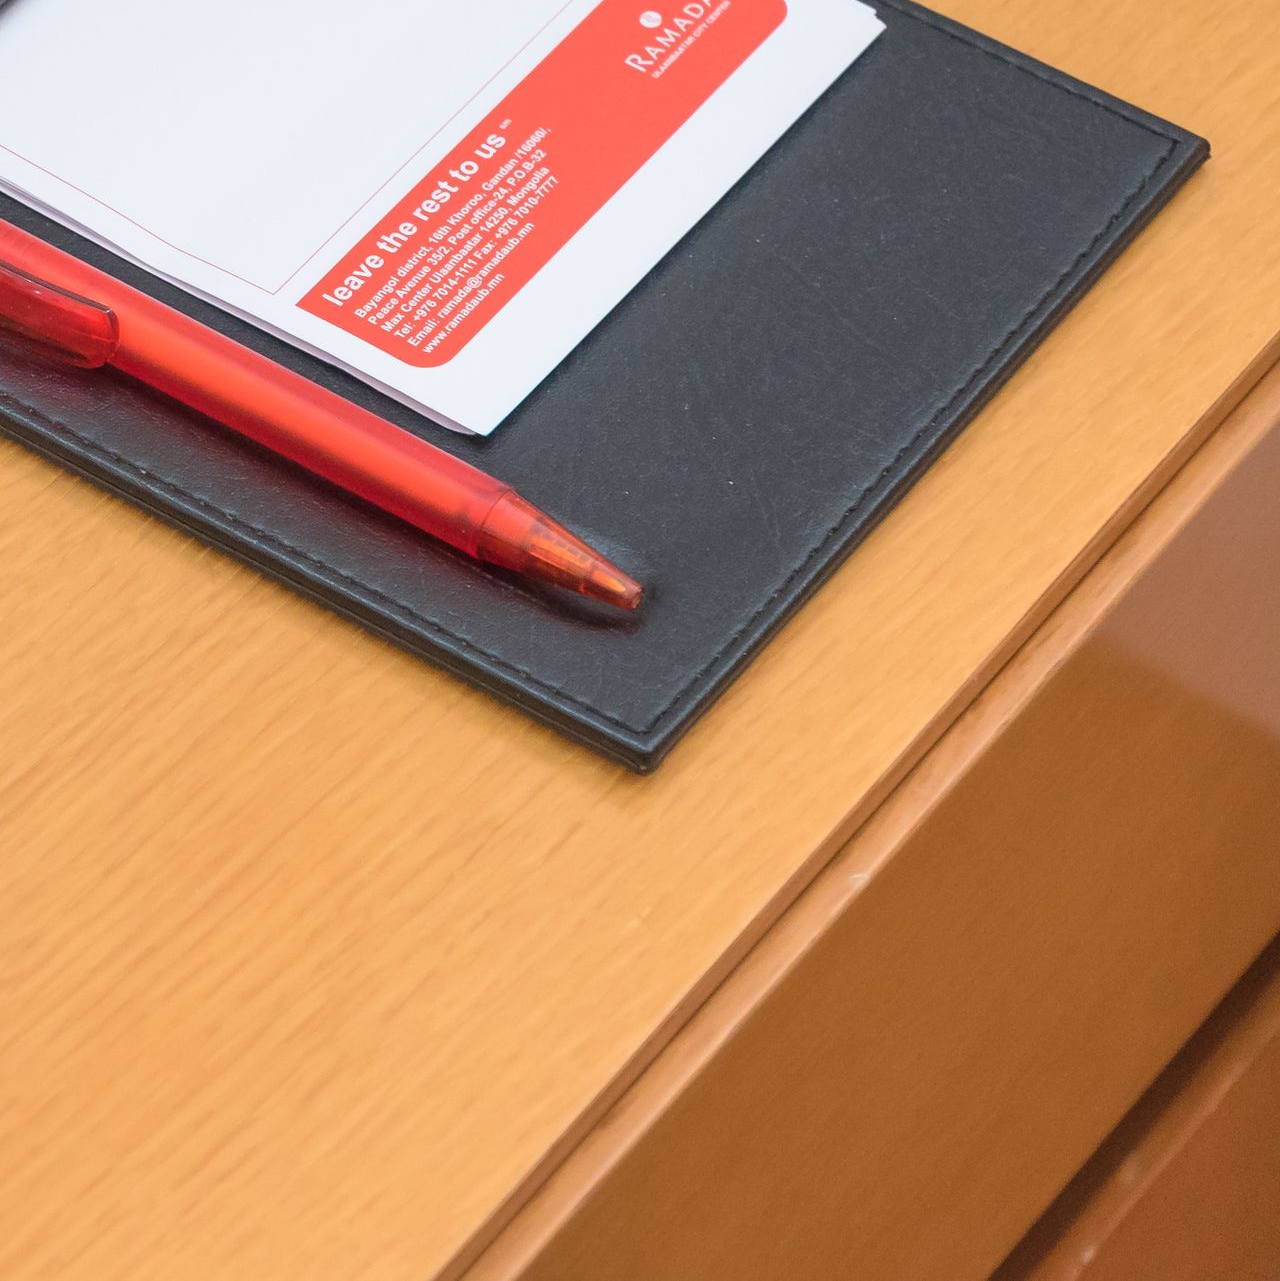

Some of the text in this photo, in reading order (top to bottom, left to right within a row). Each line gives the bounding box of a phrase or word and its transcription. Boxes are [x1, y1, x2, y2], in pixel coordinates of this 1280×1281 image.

[691, 21, 708, 38] CITY
[704, 0, 731, 24] CENTER
[321, 254, 384, 306] leave
[376, 222, 417, 253] the
[412, 180, 459, 221] rest
[448, 160, 479, 181] to
[474, 133, 506, 158] us
[353, 127, 551, 318] Bayangol district, 16th Khoroo, Gandan /16060/,
[367, 148, 546, 324] Peace Avenue 35/2, Post office-24, P.O.B-32
[380, 167, 550, 331] Max Center Ulaanbaatar 14250, Mongolia
[393, 174, 558, 337] Tel: +976 7014-1111 Fax: +976 7010-7777
[407, 222, 535, 346] Email: ramada@ramadaub.mn
[422, 273, 505, 353] www.ramadaub.mn
